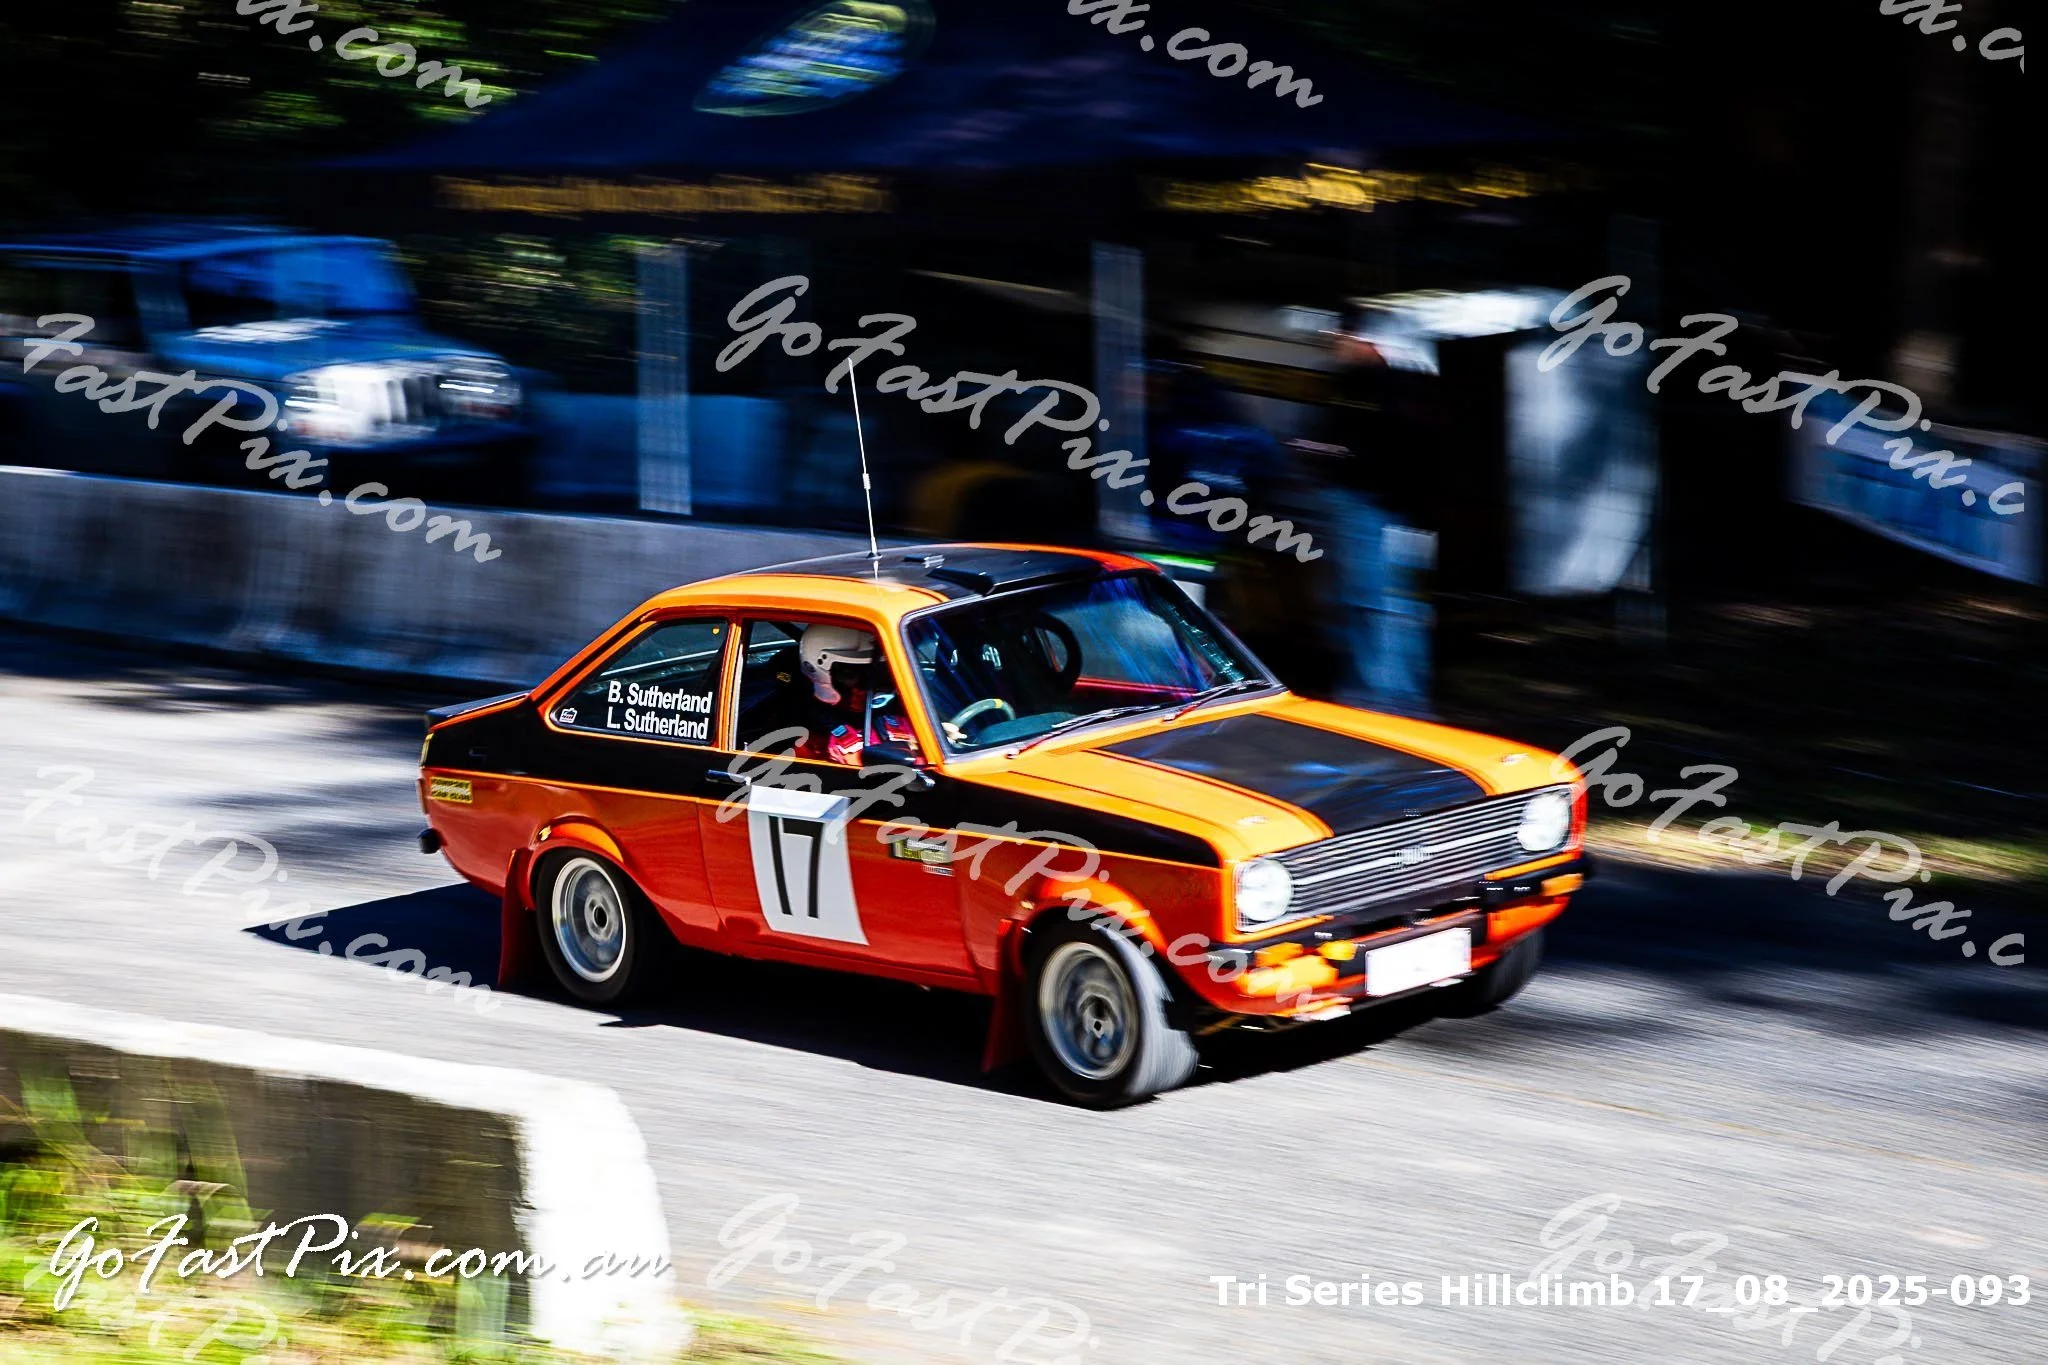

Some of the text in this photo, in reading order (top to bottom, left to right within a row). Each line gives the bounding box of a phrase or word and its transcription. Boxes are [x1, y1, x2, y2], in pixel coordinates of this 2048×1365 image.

[607, 680, 713, 713] B. Sutherland
[606, 706, 621, 729] L.
[624, 708, 710, 740] Sutherland
[768, 815, 825, 919] 17
